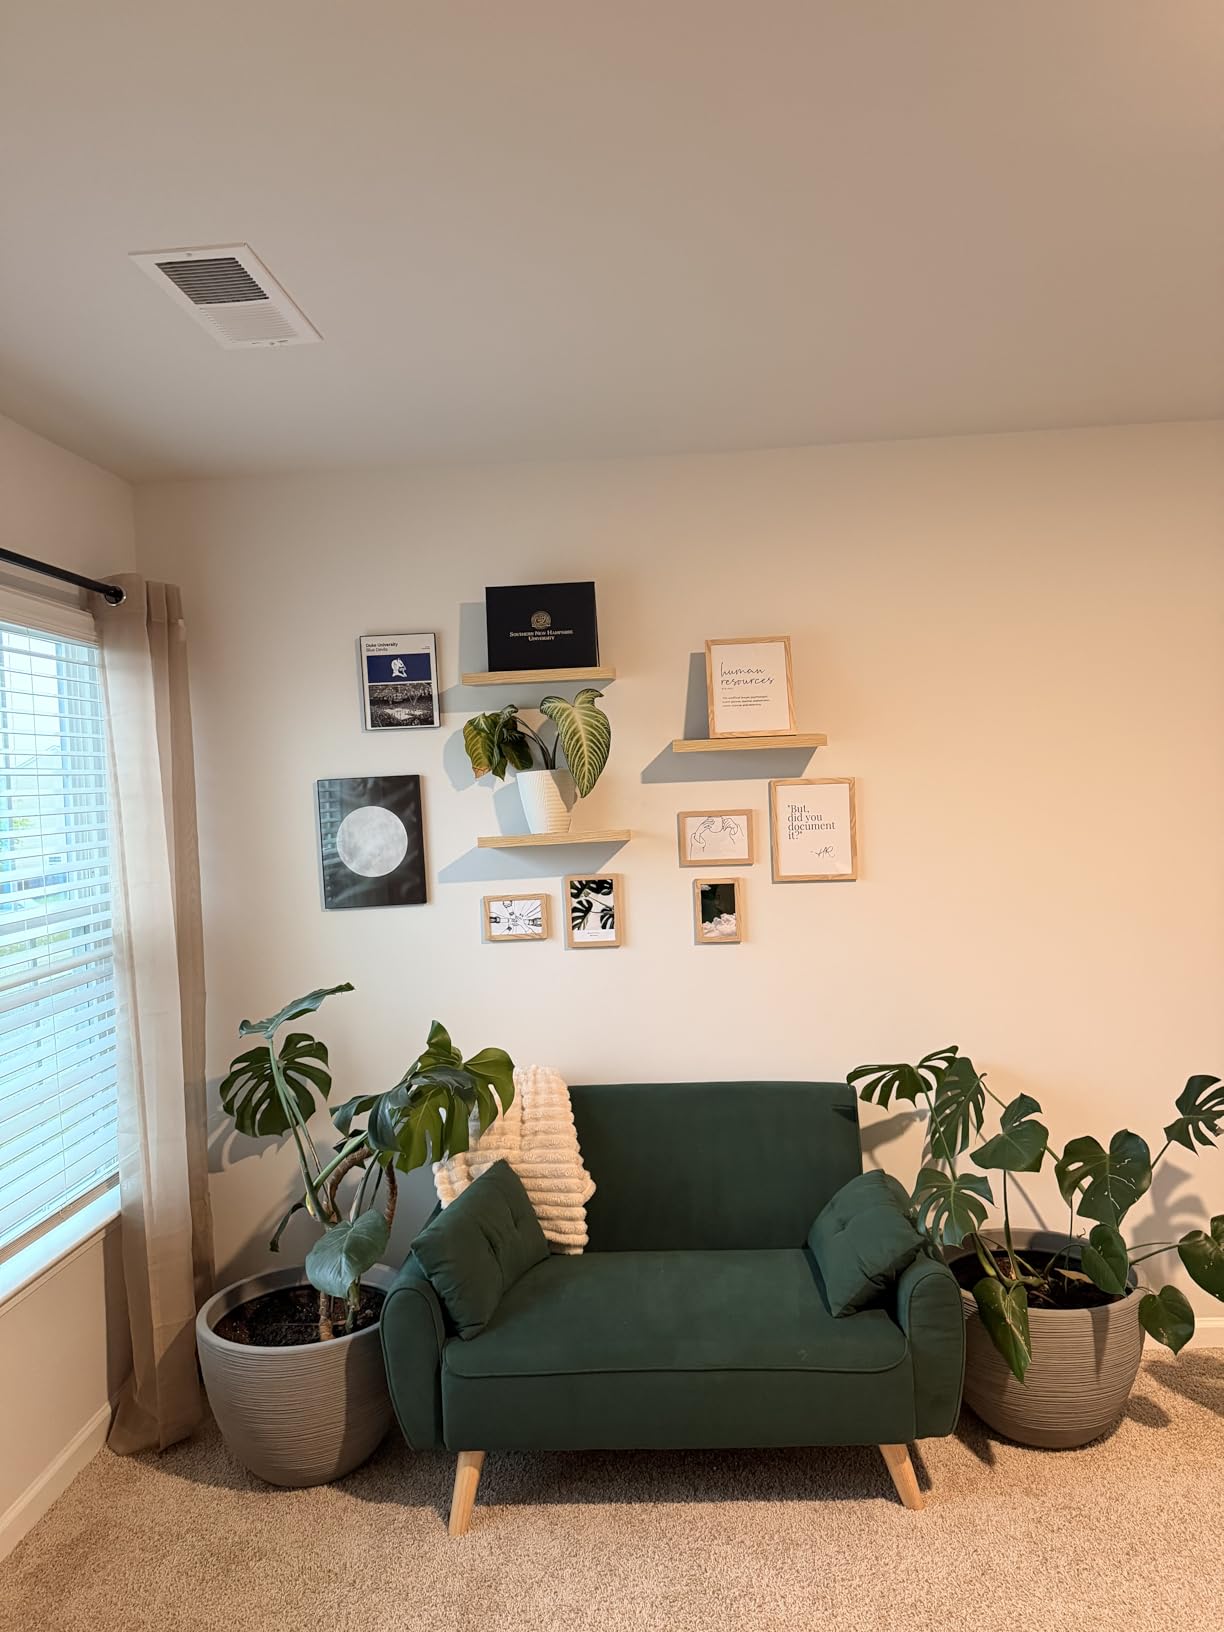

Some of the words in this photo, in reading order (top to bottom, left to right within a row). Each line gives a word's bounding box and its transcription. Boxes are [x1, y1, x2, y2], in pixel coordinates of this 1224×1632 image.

[721, 662, 764, 677] human
[721, 678, 774, 686] resources
[788, 814, 803, 822] did
[806, 815, 822, 823] you
[788, 822, 836, 830] document
